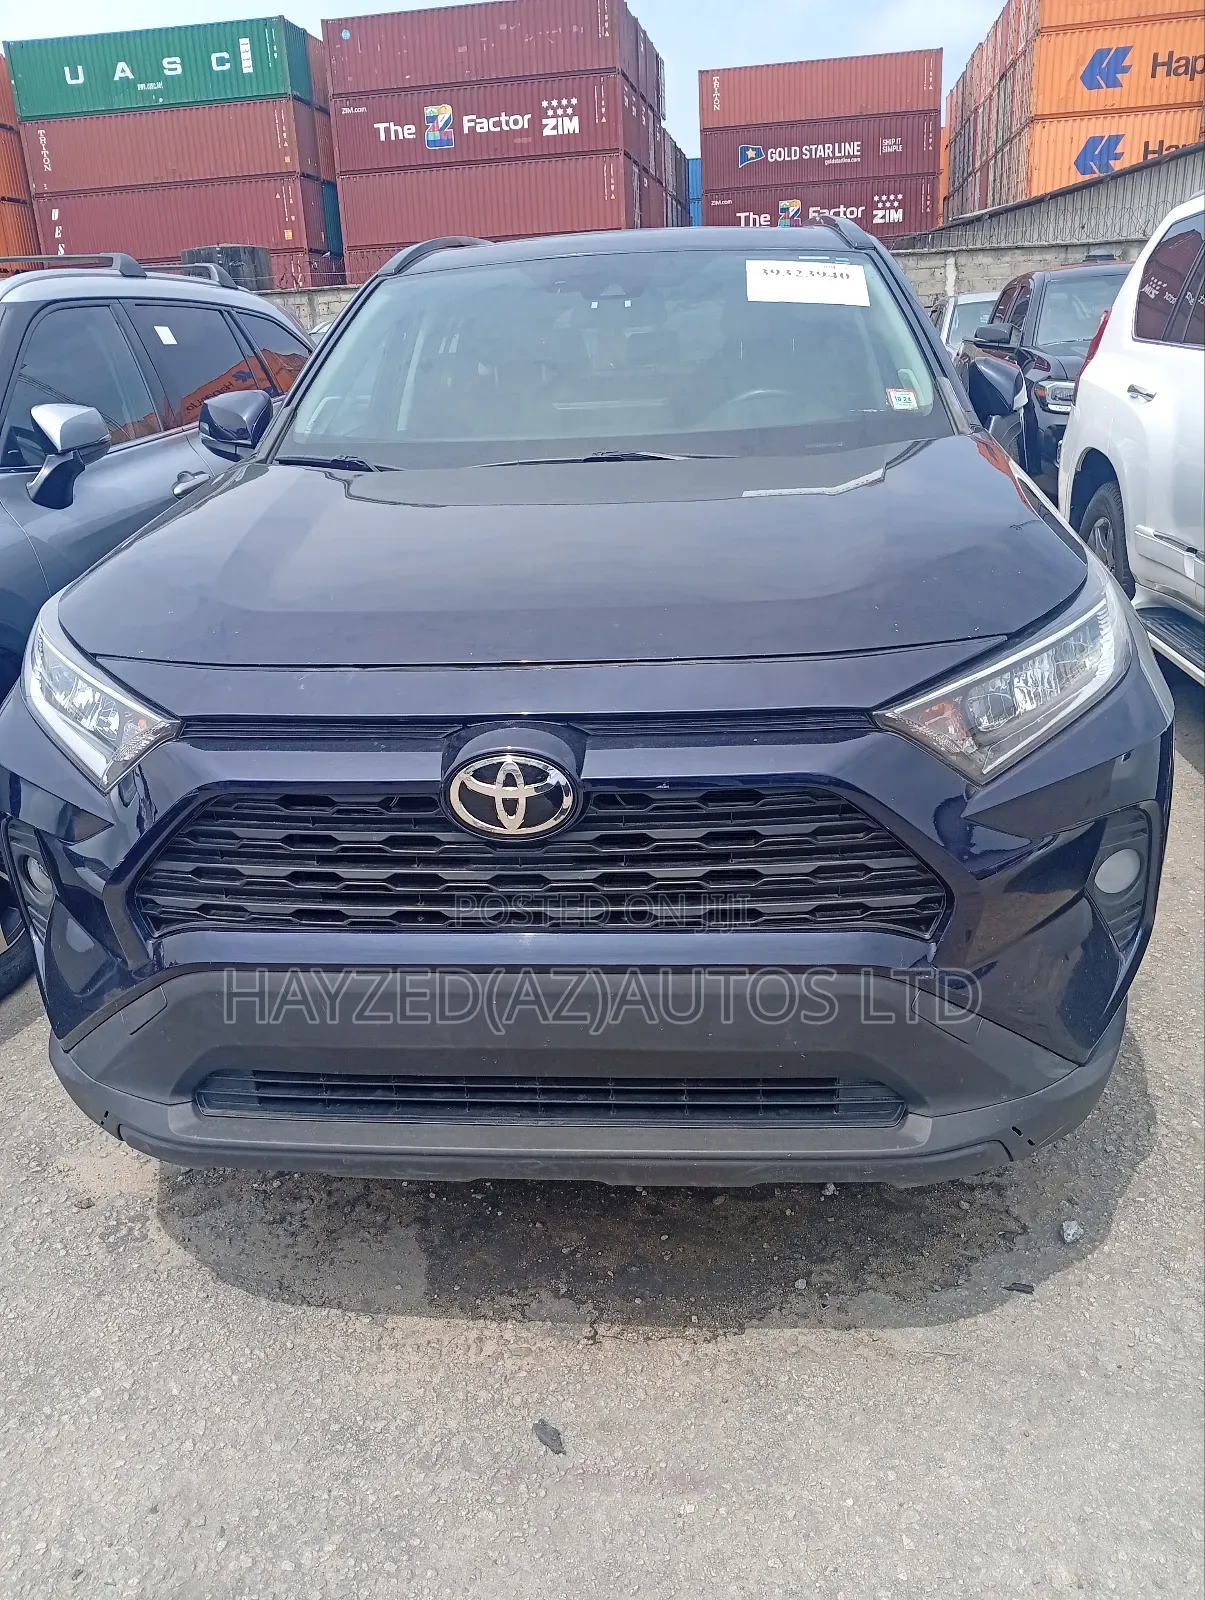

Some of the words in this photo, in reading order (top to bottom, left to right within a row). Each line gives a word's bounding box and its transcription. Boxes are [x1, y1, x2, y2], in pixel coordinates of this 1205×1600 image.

[1151, 51, 1205, 81] Hap
[712, 76, 720, 111] TRITON
[373, 122, 416, 142] The
[462, 112, 532, 134] Factor
[542, 115, 580, 137] ZIM
[38, 129, 52, 171] TRITON
[767, 146, 800, 162] GOLD
[802, 144, 833, 159] STAR
[834, 141, 861, 157] LINE
[882, 144, 903, 153] SIMPLE
[736, 211, 771, 228] The
[873, 208, 904, 224] ZIM
